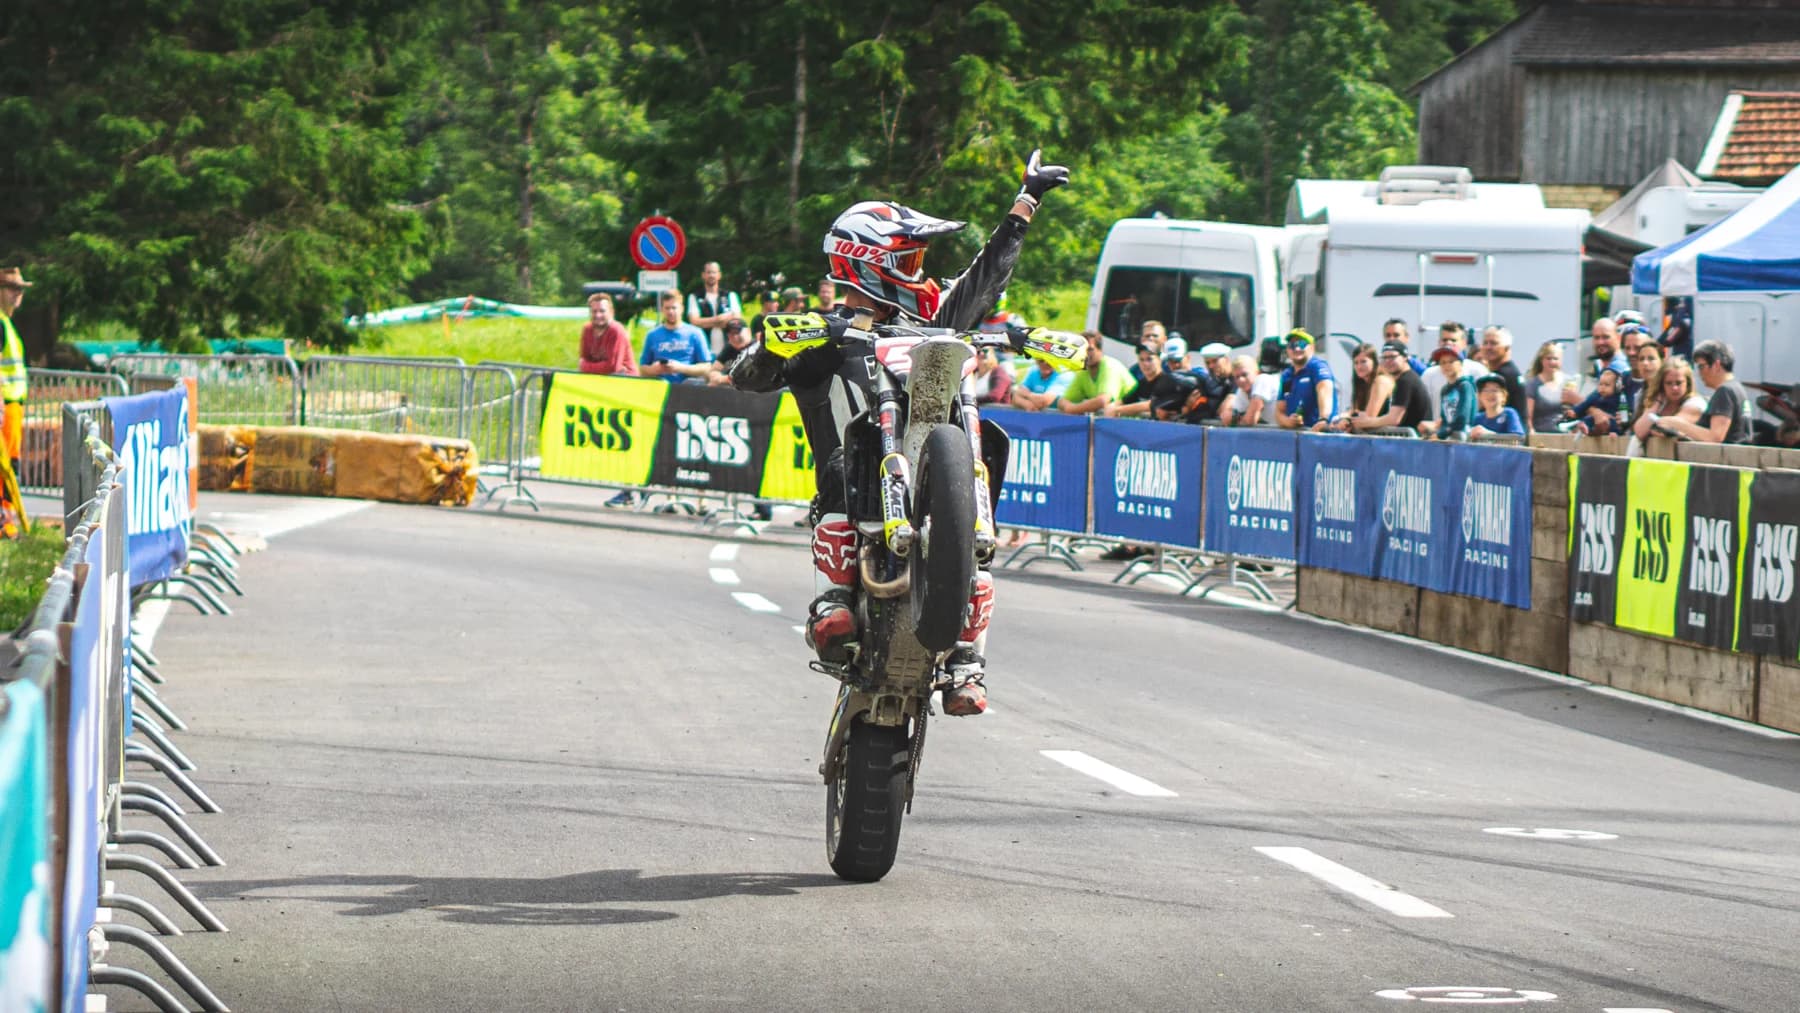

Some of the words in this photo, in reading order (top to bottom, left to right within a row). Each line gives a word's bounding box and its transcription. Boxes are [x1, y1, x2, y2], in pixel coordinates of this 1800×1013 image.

[833, 239, 887, 264] 100%
[1129, 449, 1178, 501] YAMAHA
[1241, 459, 1294, 512] YAMAHA
[999, 488, 1047, 504] CING
[1323, 467, 1355, 522] YAMAHA
[1116, 500, 1172, 519] RACING
[1230, 513, 1289, 532] RACING
[1316, 526, 1353, 544] RACING
